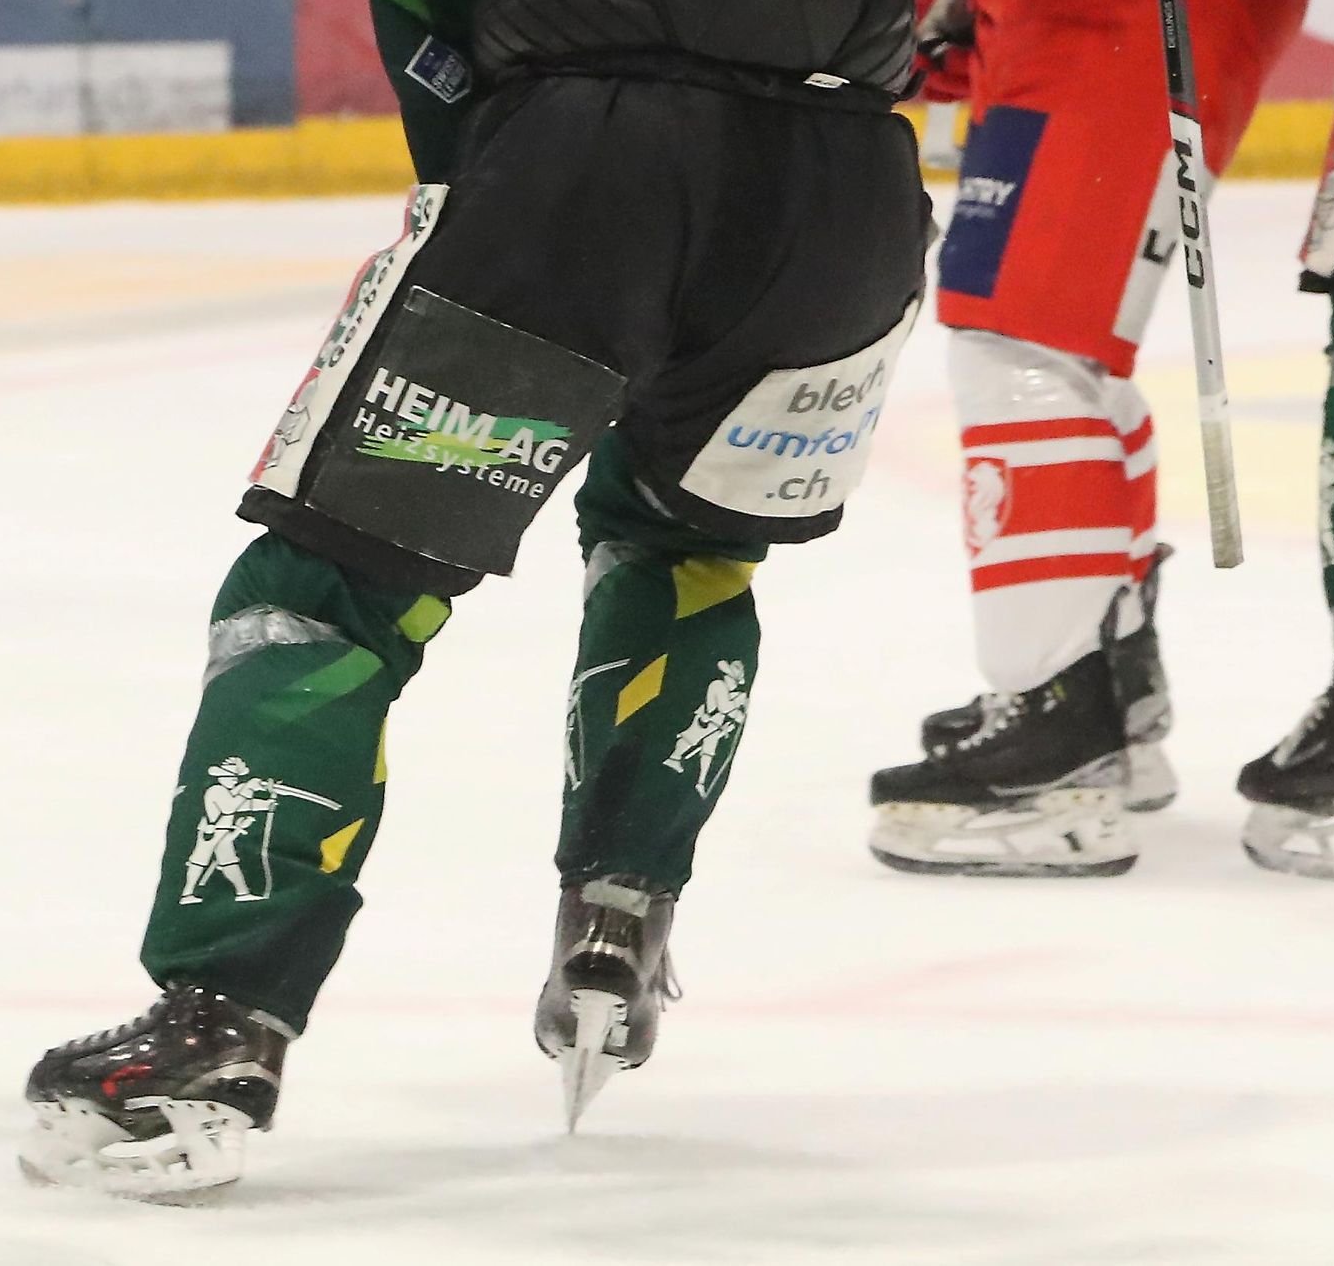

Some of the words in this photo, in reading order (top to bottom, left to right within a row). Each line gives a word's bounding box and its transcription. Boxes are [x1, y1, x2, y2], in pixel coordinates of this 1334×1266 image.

[1173, 136, 1206, 290] CCM
[364, 366, 498, 449] HEIM
[497, 425, 571, 474] AG
[787, 357, 885, 415] blech
[352, 406, 546, 499] Heizsysteme
[765, 467, 832, 501] .ch
